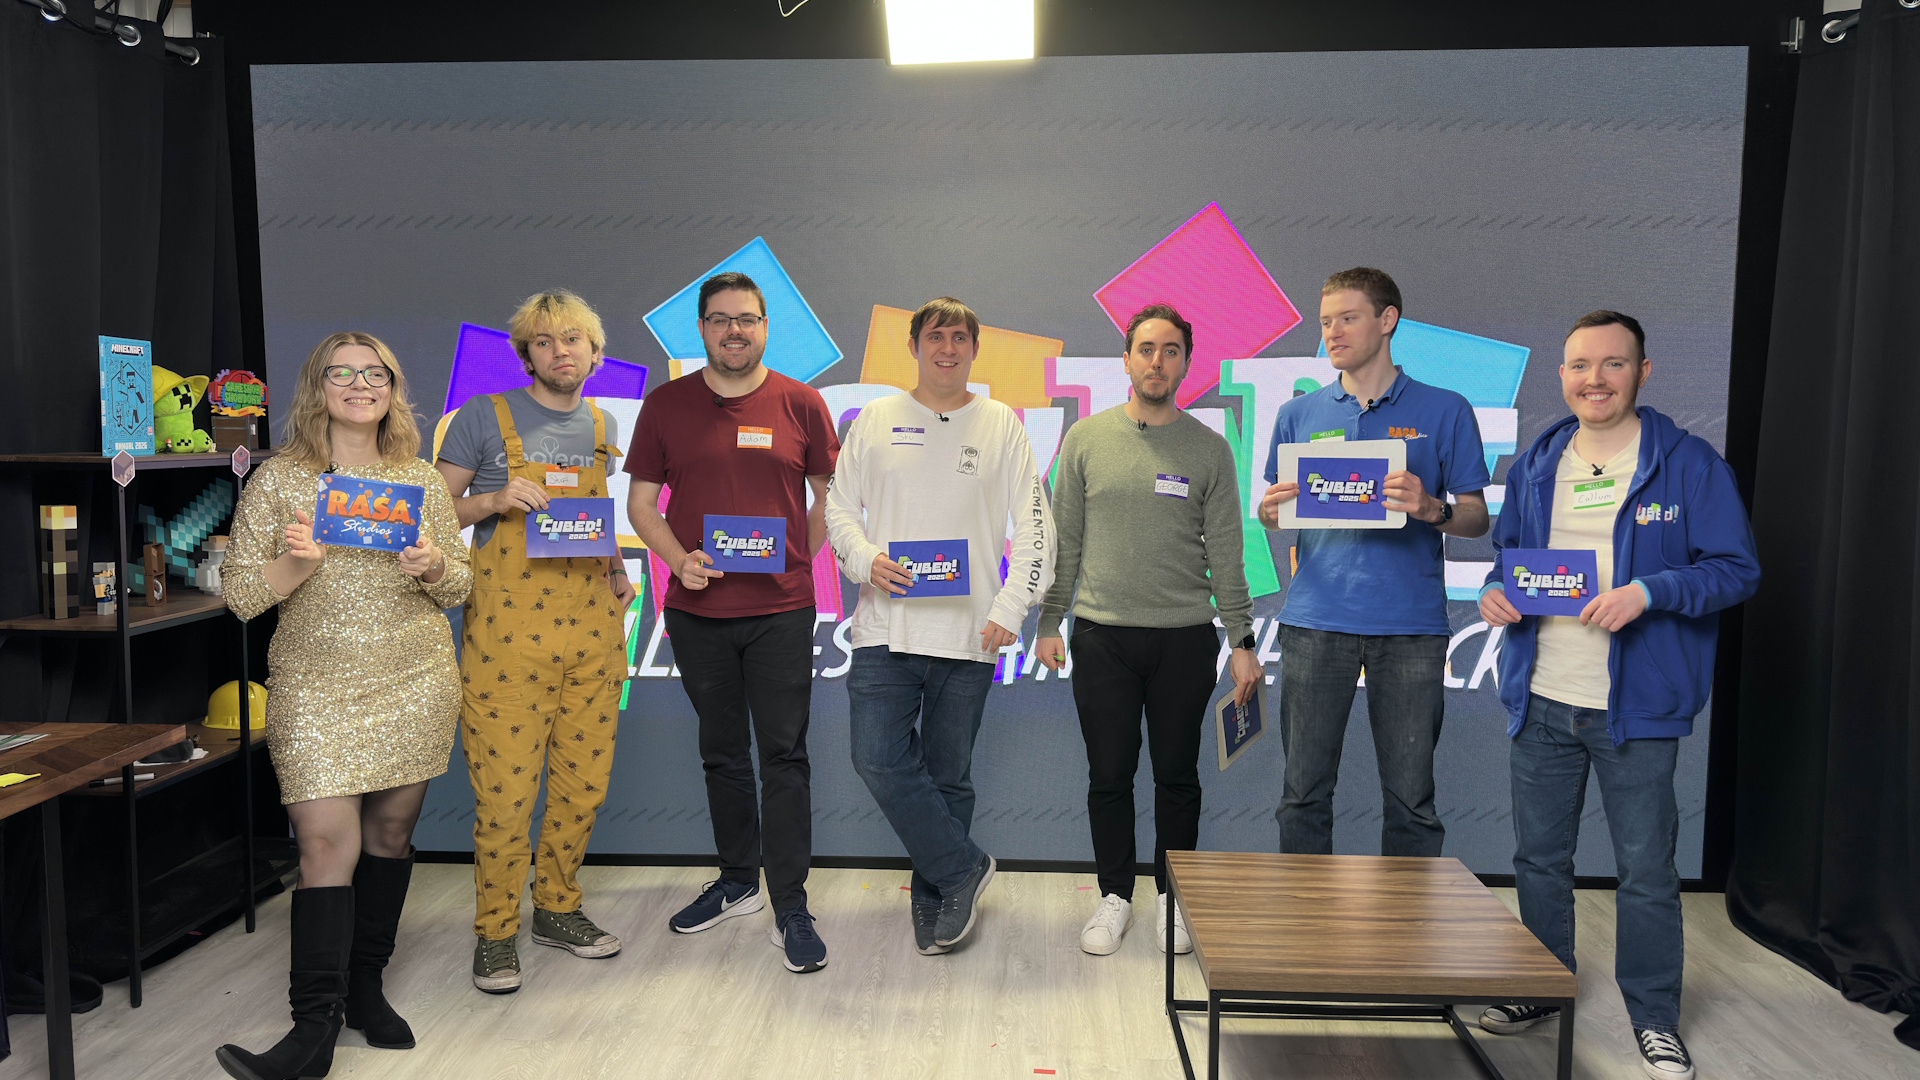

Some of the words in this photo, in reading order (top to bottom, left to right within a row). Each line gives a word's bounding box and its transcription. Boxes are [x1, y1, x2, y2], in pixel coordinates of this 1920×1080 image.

[111, 344, 144, 356] MINECRAFT
[739, 434, 768, 443] Adam
[896, 433, 914, 441] Stu
[1157, 481, 1188, 493] GEORGE
[1310, 479, 1375, 494] CUBED!
[1578, 492, 1611, 503] Callum
[326, 489, 411, 525] RASA
[341, 519, 393, 535] Studios
[539, 518, 602, 533] CUBED!
[716, 535, 774, 550] CUBED!
[902, 559, 957, 573] CUBED!
[1517, 572, 1583, 588] CUBED!
[1547, 589, 1570, 597] 2025
